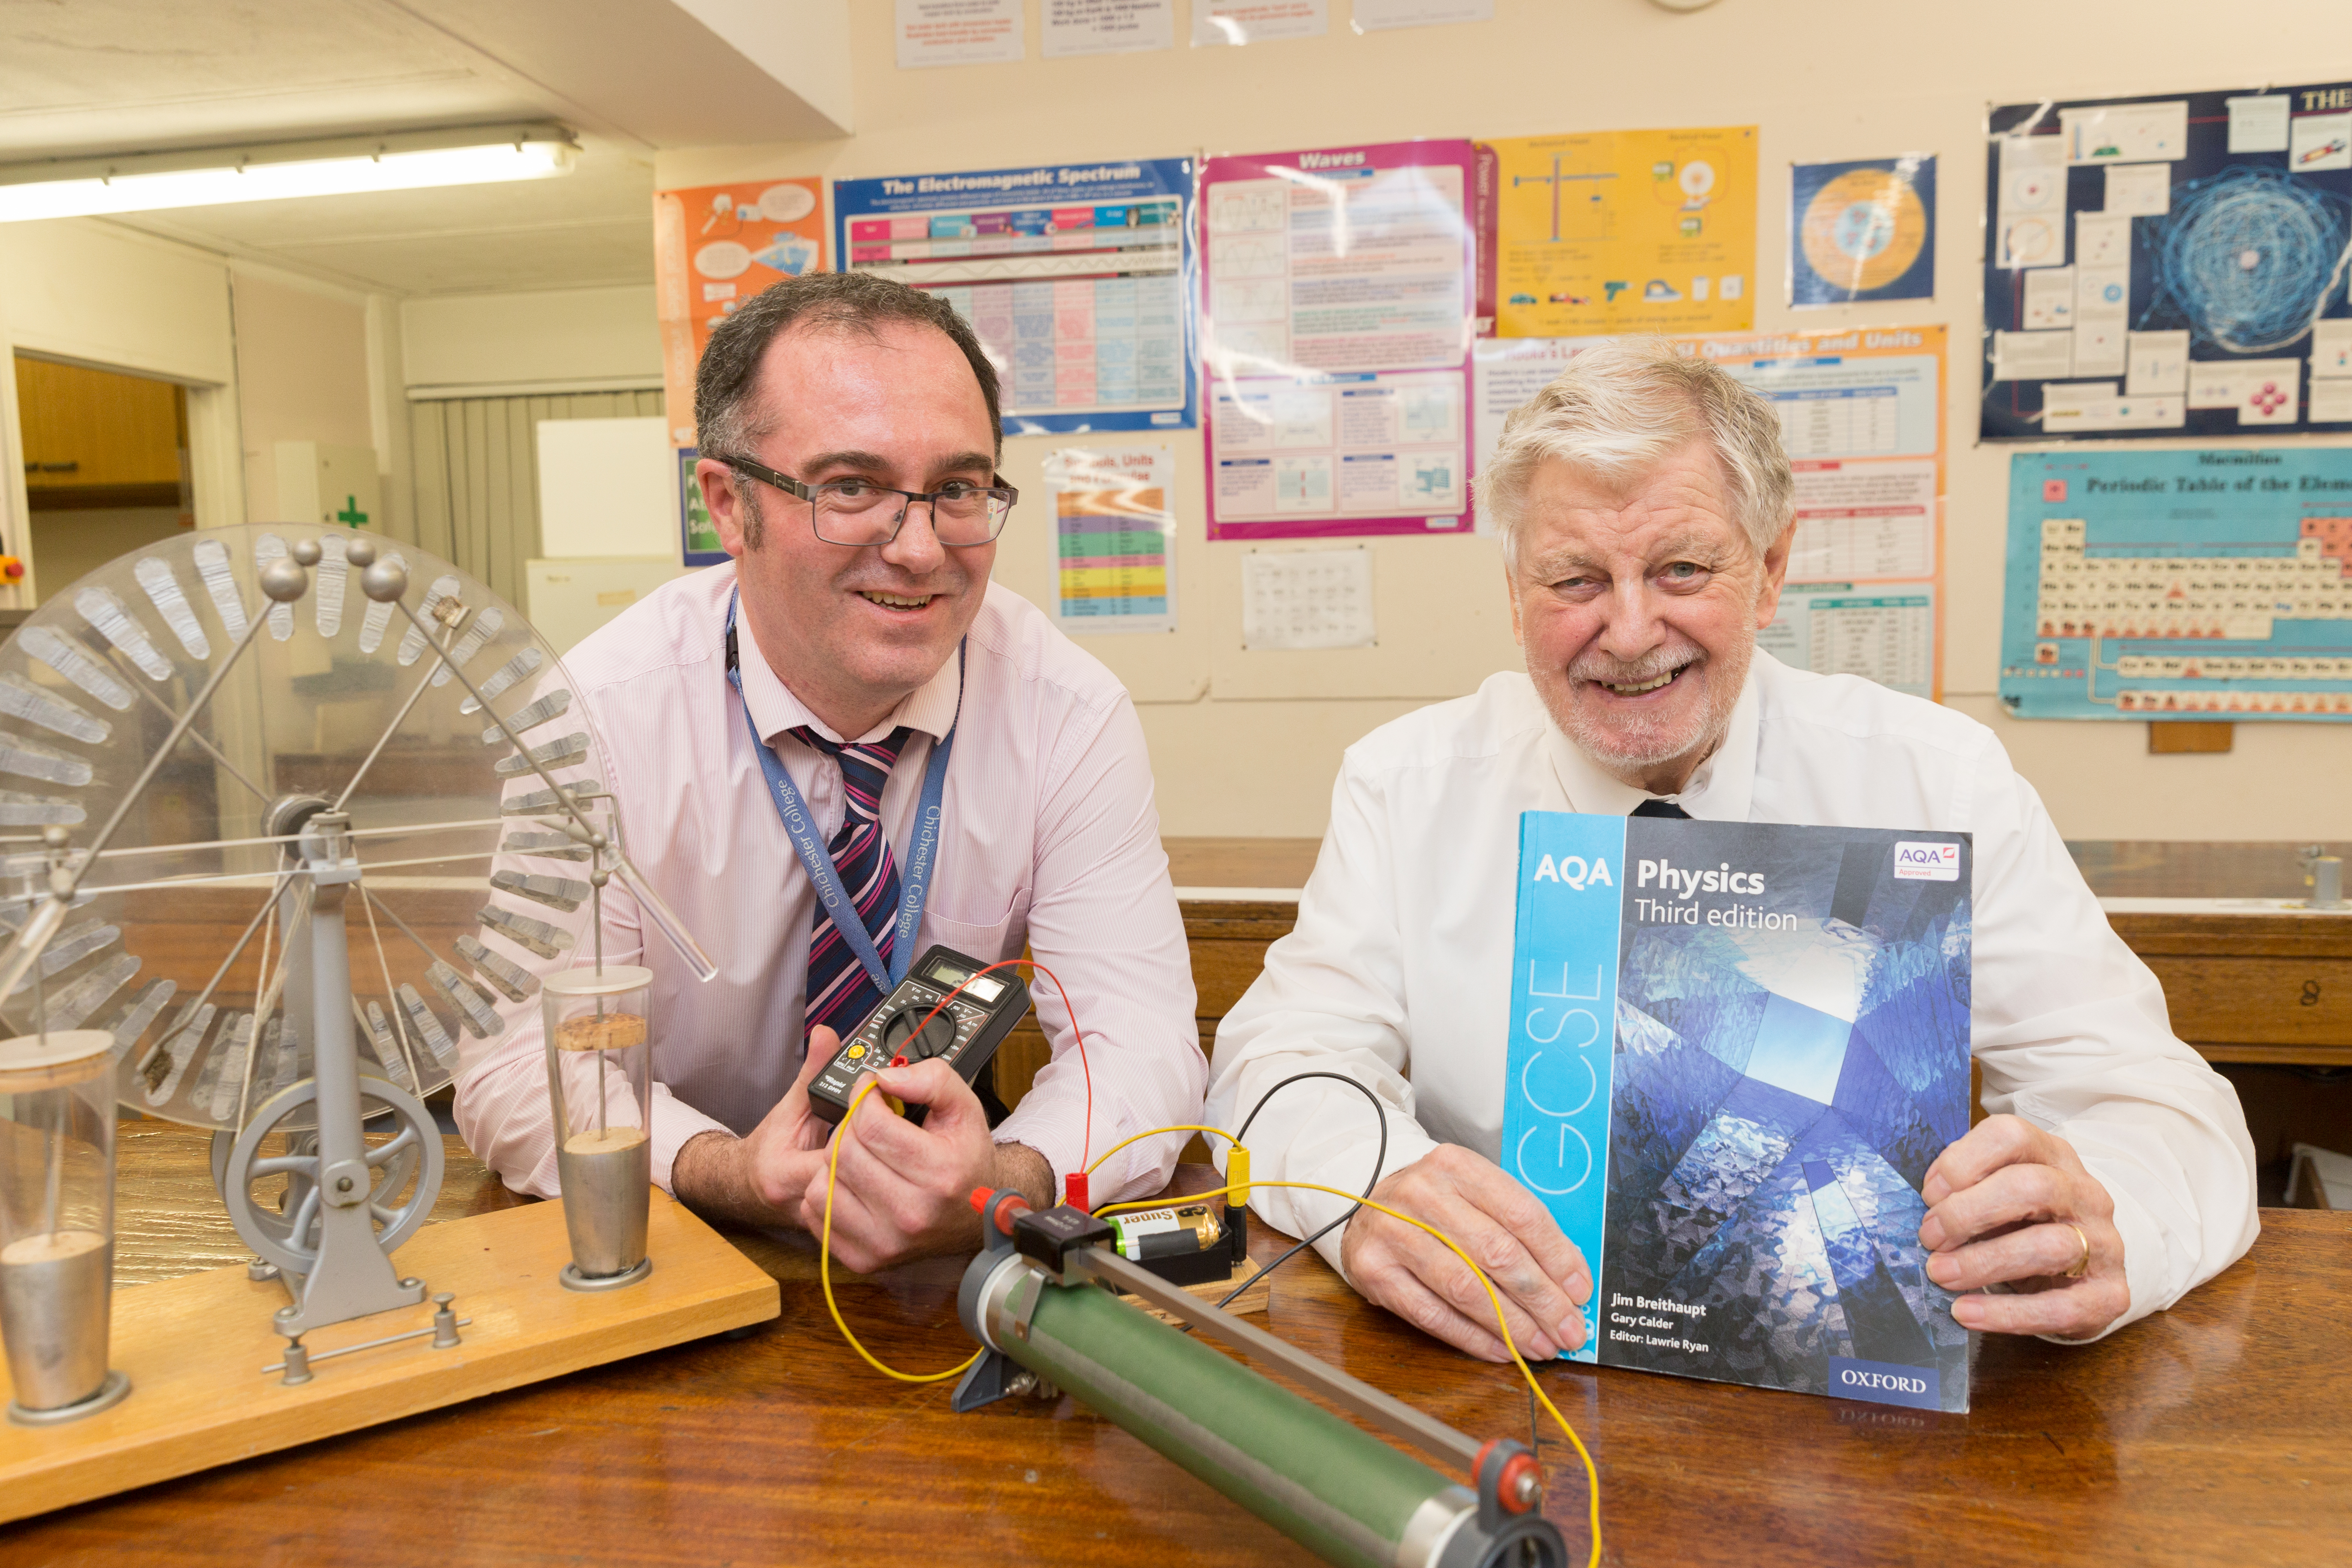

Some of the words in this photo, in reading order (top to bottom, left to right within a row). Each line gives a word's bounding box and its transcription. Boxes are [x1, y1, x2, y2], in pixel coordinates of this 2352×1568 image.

[2299, 88, 2352, 111] THE
[1299, 151, 1365, 170] Waves
[883, 178, 915, 196] The
[918, 166, 1054, 194] Electromagnetic
[1058, 166, 1142, 186] Spectrum
[1818, 333, 1859, 352] and
[1866, 330, 1923, 349] Units
[2197, 452, 2283, 467] Macmillan
[2086, 476, 2166, 493] Periodic
[2176, 476, 2226, 493] Table
[2233, 476, 2256, 492] of
[2260, 477, 2292, 493] the
[778, 780, 805, 834] College
[912, 805, 940, 880] Chichester
[1899, 849, 1941, 864] AQA
[800, 836, 839, 908] Chichester
[1534, 854, 1613, 891] AQA
[1637, 859, 1765, 900] Physics
[1899, 869, 1932, 877] Approved
[898, 884, 922, 938] College
[1635, 898, 1699, 926] Third
[1707, 907, 1798, 932] edition
[827, 1076, 846, 1088] Rapid
[828, 1084, 842, 1094] DMM
[1516, 959, 1602, 1195] GCSE
[1124, 1209, 1174, 1225] Super
[1611, 1293, 1633, 1307] Jim
[1636, 1296, 1707, 1318] Breithaupt
[1611, 1312, 1637, 1327] Gary
[1638, 1316, 1674, 1329] Calder
[1610, 1329, 1644, 1343] Editor:
[1646, 1334, 1680, 1348] Lawrie
[1682, 1339, 1709, 1353] Ryan
[1841, 1369, 1927, 1394] OXFORD
